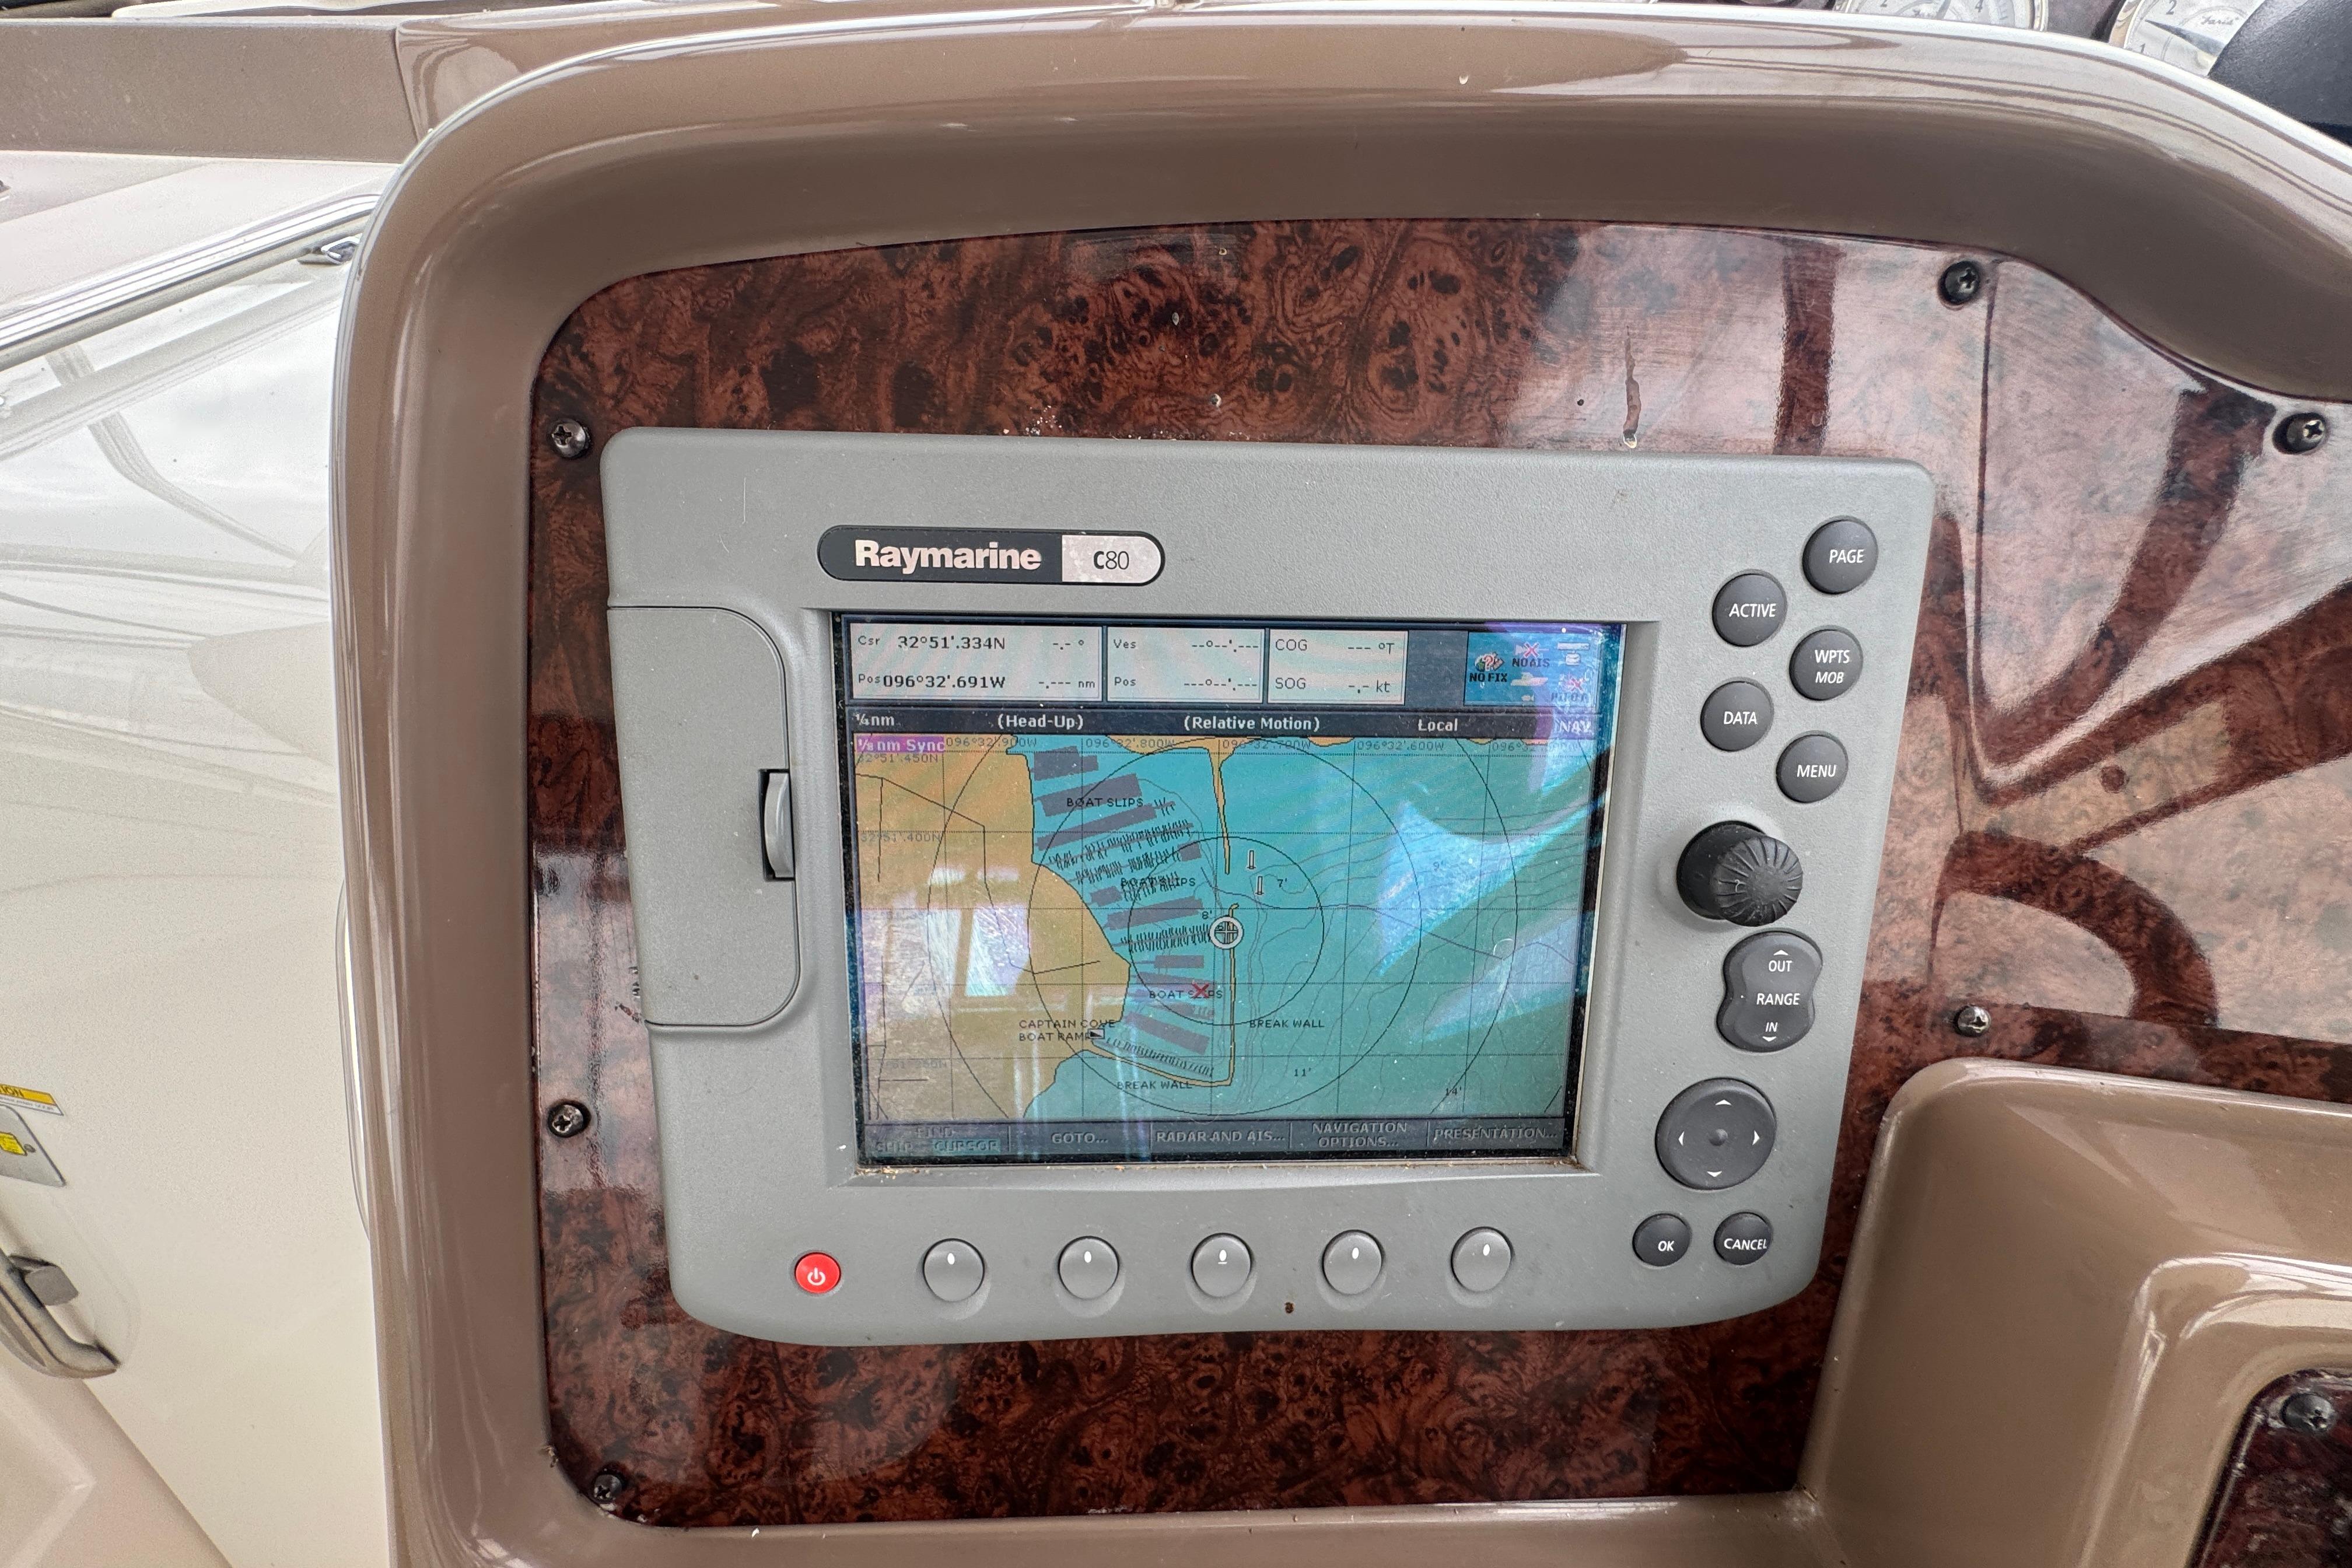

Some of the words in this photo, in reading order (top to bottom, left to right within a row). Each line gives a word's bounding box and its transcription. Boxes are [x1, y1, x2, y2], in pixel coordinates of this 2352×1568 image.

[855, 540, 1041, 574] Raymarine
[1093, 551, 1129, 569] C80
[1829, 549, 1864, 564] PAGE
[1728, 603, 1776, 618] ACTIVE
[858, 636, 880, 646] Csr
[1114, 639, 1136, 649] Ves
[1275, 639, 1307, 652] COG
[1815, 649, 1850, 664] WPTS
[859, 674, 880, 684] Pos
[1115, 677, 1136, 687] Pos
[1275, 677, 1307, 690] SOG
[1469, 673, 1485, 682] NO
[1488, 673, 1507, 682] FIX
[1815, 671, 1844, 684] MOB
[998, 713, 1084, 729] (Head-Up)
[1184, 716, 1255, 731] (Relative
[1261, 716, 1320, 732] Motion)
[1724, 711, 1758, 725] DATA
[1418, 719, 1458, 732] Local
[907, 739, 945, 753] Sync
[1797, 765, 1836, 778] MENU
[1067, 797, 1103, 807] BOAT
[1107, 797, 1143, 807] SLIPS
[1768, 960, 1793, 972] OUT
[1149, 991, 1184, 999] BOAT
[1188, 990, 1223, 999] SPS
[1756, 993, 1800, 1006] RANGE
[1019, 1019, 1076, 1028] CAPTAIN
[1250, 1019, 1289, 1028] BREAK
[1293, 1020, 1325, 1028] WALL
[1765, 1022, 1778, 1032] IN
[1019, 1032, 1054, 1041] BOAT
[1117, 1080, 1156, 1090] BREAK
[1160, 1080, 1192, 1089] WALL
[1312, 1121, 1408, 1134] NAVIGATION
[1156, 1131, 1206, 1142] RADAR
[1210, 1131, 1242, 1142] AND
[1658, 1240, 1674, 1252] OK
[1724, 1238, 1768, 1251] CANCEL
